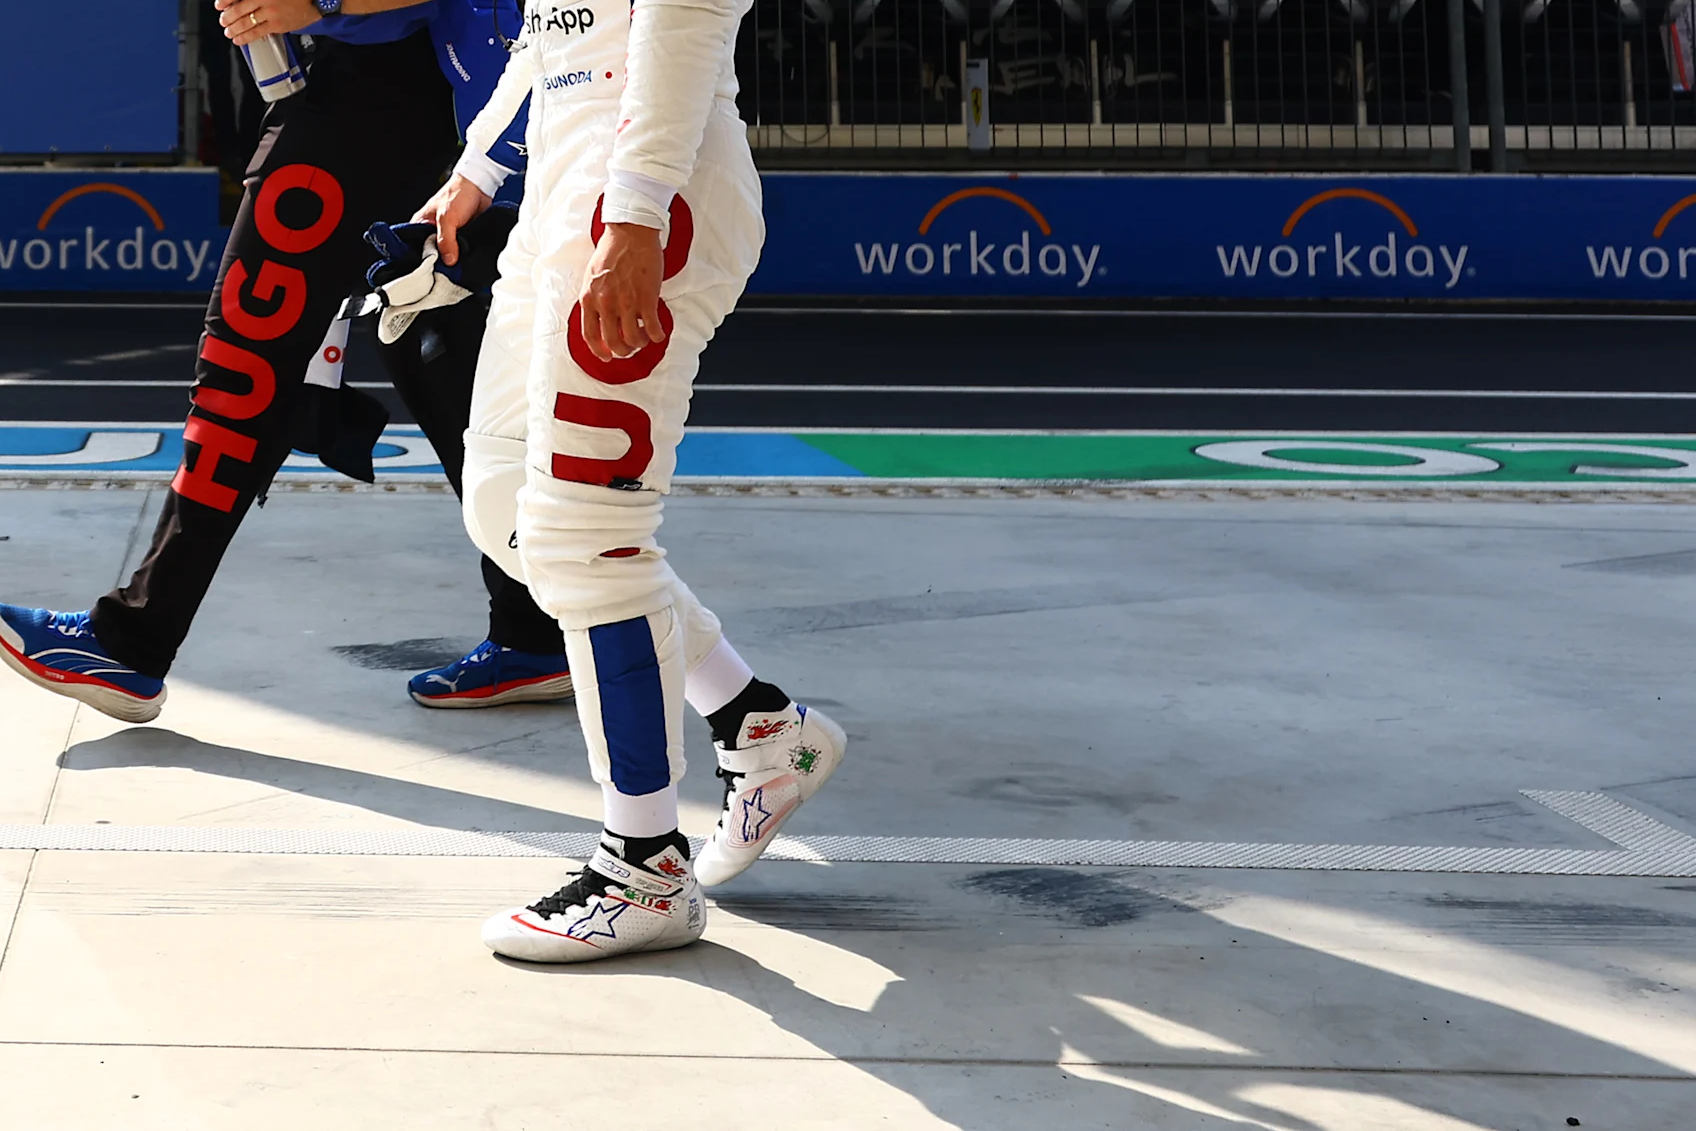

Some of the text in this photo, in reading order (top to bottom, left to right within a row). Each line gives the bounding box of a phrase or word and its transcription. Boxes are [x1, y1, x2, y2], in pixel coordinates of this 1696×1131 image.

[546, 6, 595, 35] App
[544, 70, 593, 90] SUNODA
[170, 163, 345, 513] HUGO
